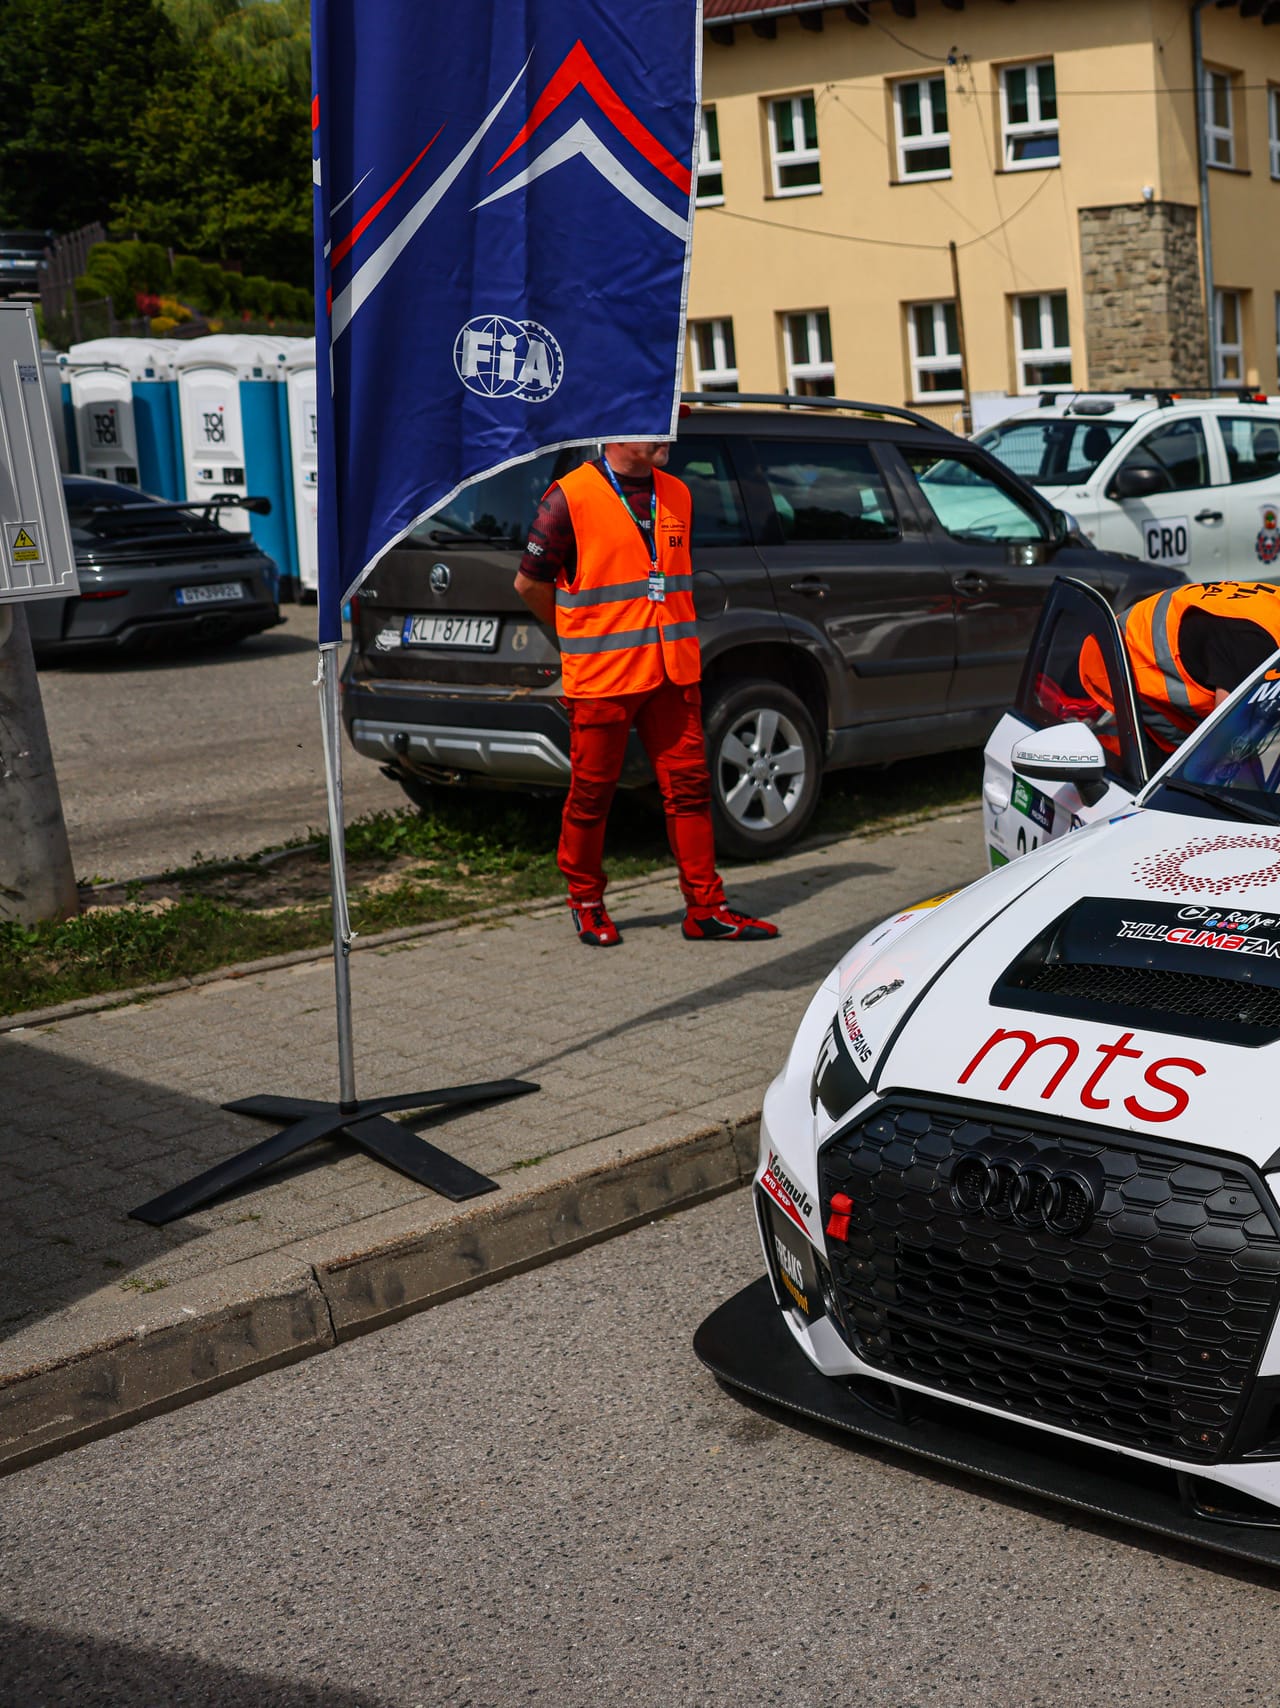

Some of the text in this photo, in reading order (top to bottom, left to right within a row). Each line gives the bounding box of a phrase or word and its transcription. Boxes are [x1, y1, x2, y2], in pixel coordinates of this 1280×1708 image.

[669, 536, 683, 547] BK
[1147, 526, 1187, 560] CRO
[443, 618, 494, 644] 87112
[957, 1028, 1207, 1123] mts
[770, 1154, 813, 1218] formula
[777, 1188, 791, 1207] SHOP
[774, 1234, 804, 1290] FREAKS
